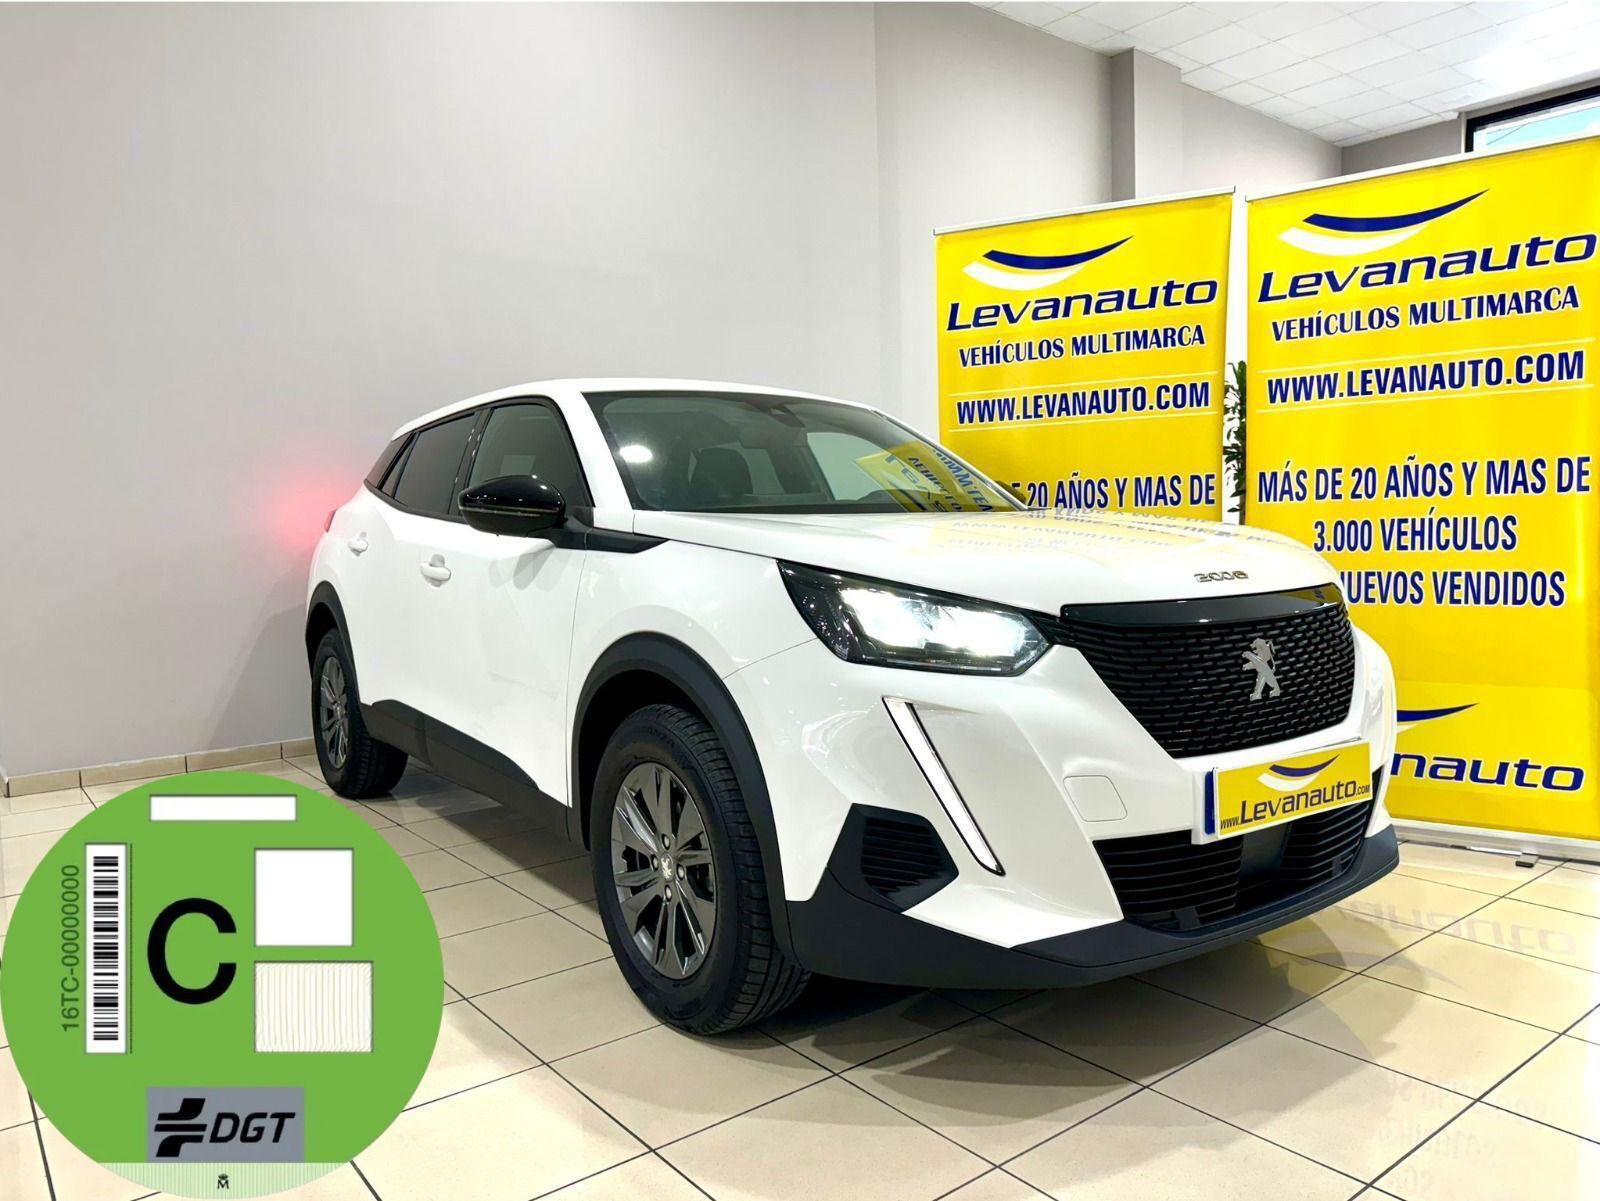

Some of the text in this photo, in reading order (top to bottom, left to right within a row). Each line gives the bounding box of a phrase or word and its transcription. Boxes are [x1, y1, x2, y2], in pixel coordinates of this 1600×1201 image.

[1258, 234, 1598, 302] Levanauto
[947, 280, 1218, 331] Levanauto
[1272, 285, 1579, 341] VEHÍCULOS MULTIMARCA
[959, 324, 1205, 367] VEHÍCULOS MULTIMARCA
[1268, 350, 1584, 404] WWW.LEVANAUTO.COM
[957, 382, 1210, 424] WWW.LEVANAUTO.COM
[1027, 472, 1215, 509] 20 AÑOS Y MAS DE
[1258, 455, 1591, 503] MÁS DE 20 AÑOS Y MAS DE
[1313, 507, 1517, 553] 3.000 VEHÍCULOS
[1340, 571, 1565, 606] UEVOS VENDIDOS
